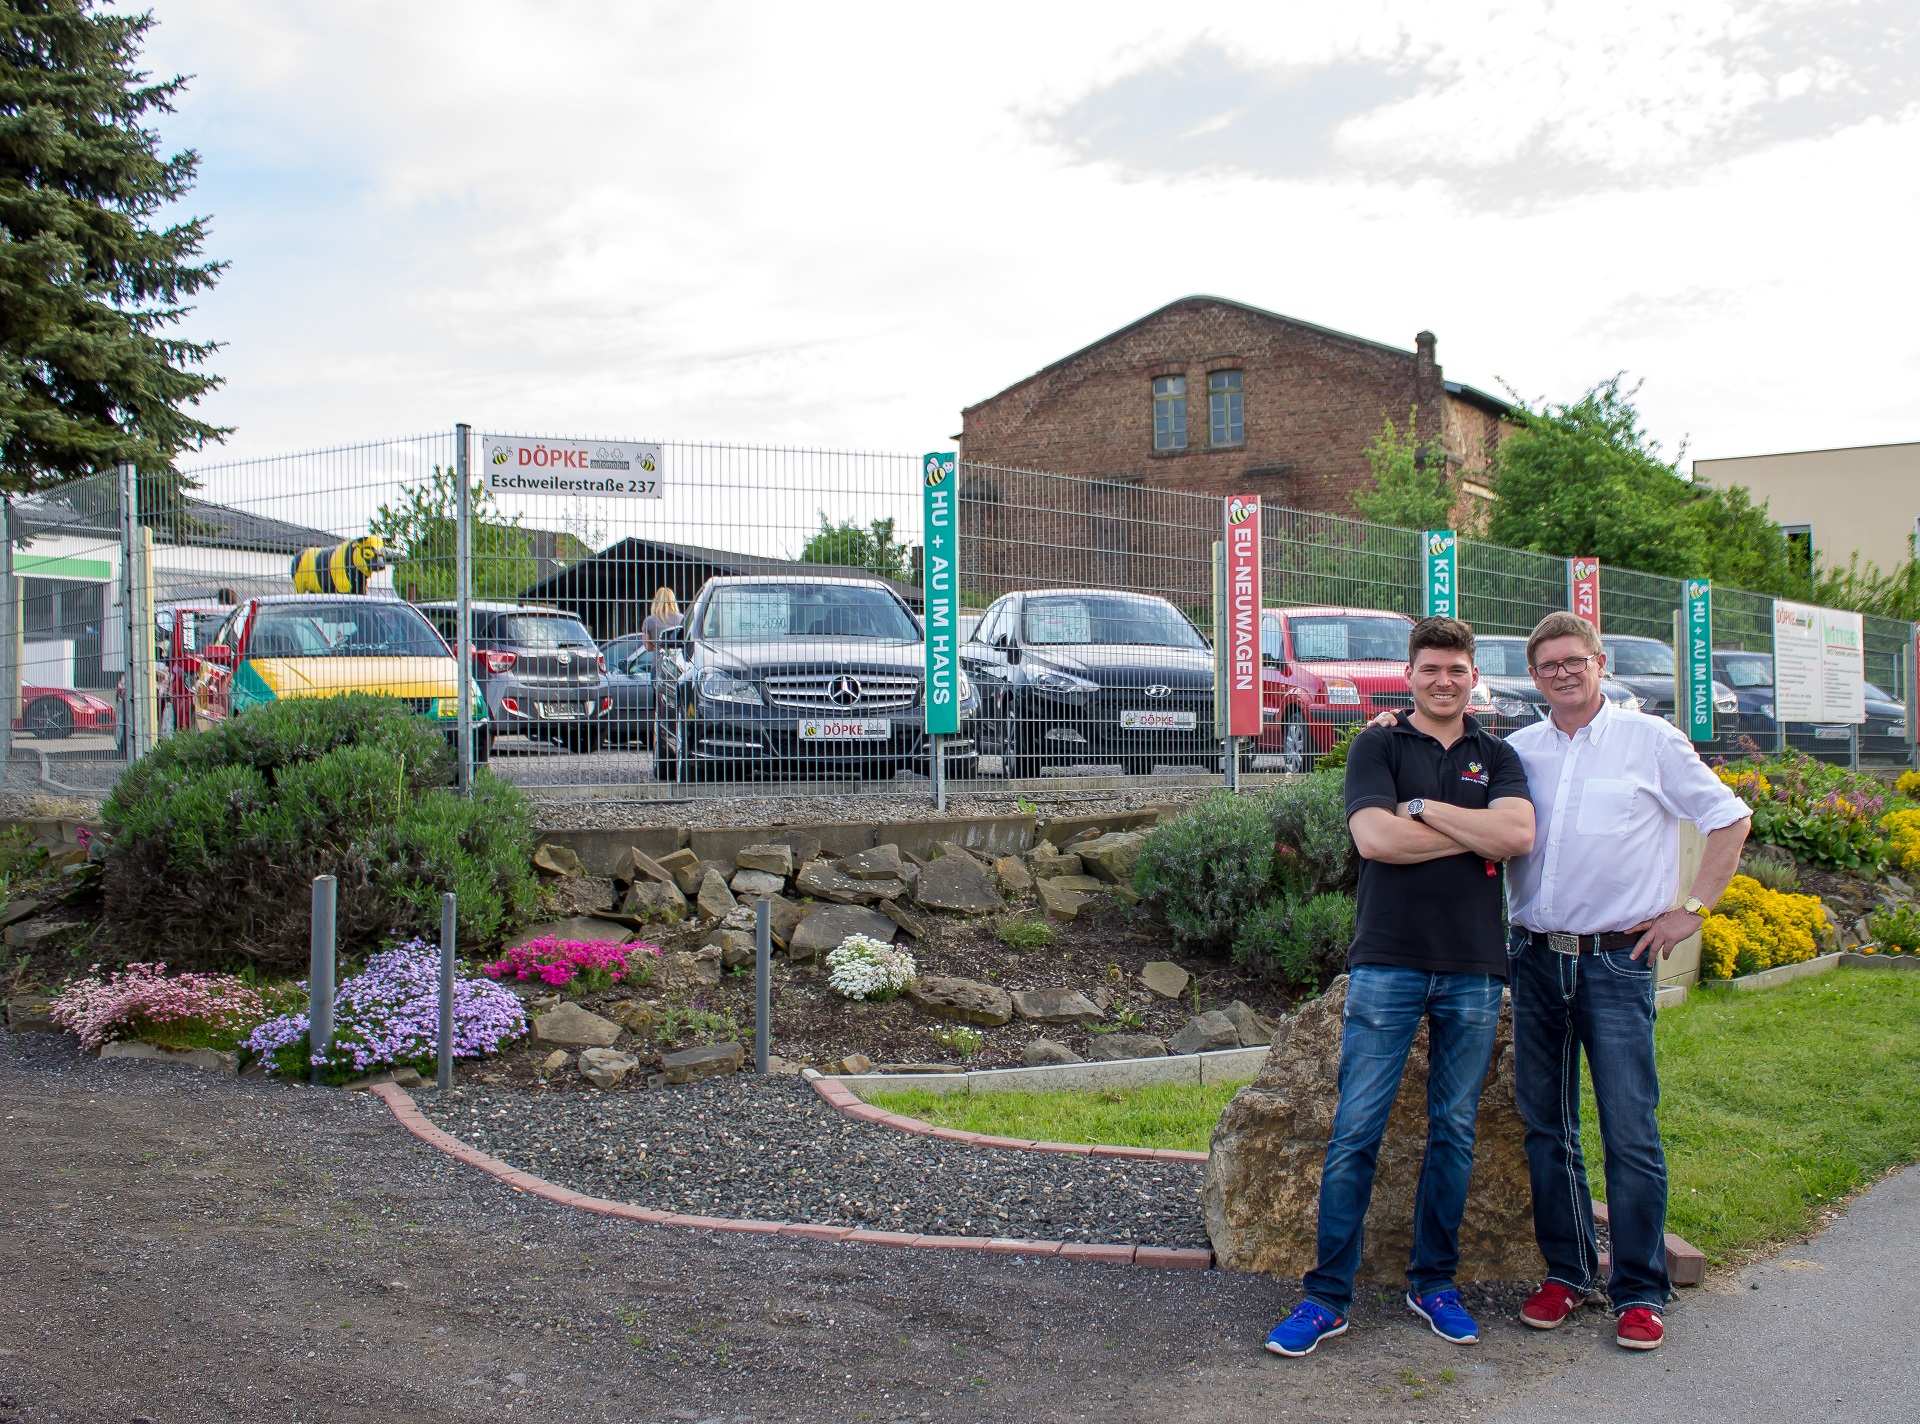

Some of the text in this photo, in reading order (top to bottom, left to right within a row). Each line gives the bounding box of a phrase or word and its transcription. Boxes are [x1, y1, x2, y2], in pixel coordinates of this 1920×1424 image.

[518, 444, 589, 468] DÖPKE
[491, 474, 656, 493] Eschweilerstraße 237
[931, 490, 948, 527] HU
[932, 555, 949, 590] AU
[1434, 559, 1450, 595] KFZ
[933, 598, 949, 627] IM
[1234, 528, 1253, 690] EU-NEUWAGEN
[1579, 583, 1593, 615] KFZ
[1693, 601, 1706, 623] HU
[1694, 638, 1707, 659] AU
[933, 635, 950, 705] HAUS
[1694, 663, 1707, 681] IM
[1695, 684, 1708, 725] HAUS
[824, 722, 863, 736] DÖPKE
[1140, 714, 1173, 726] DÖPKE
